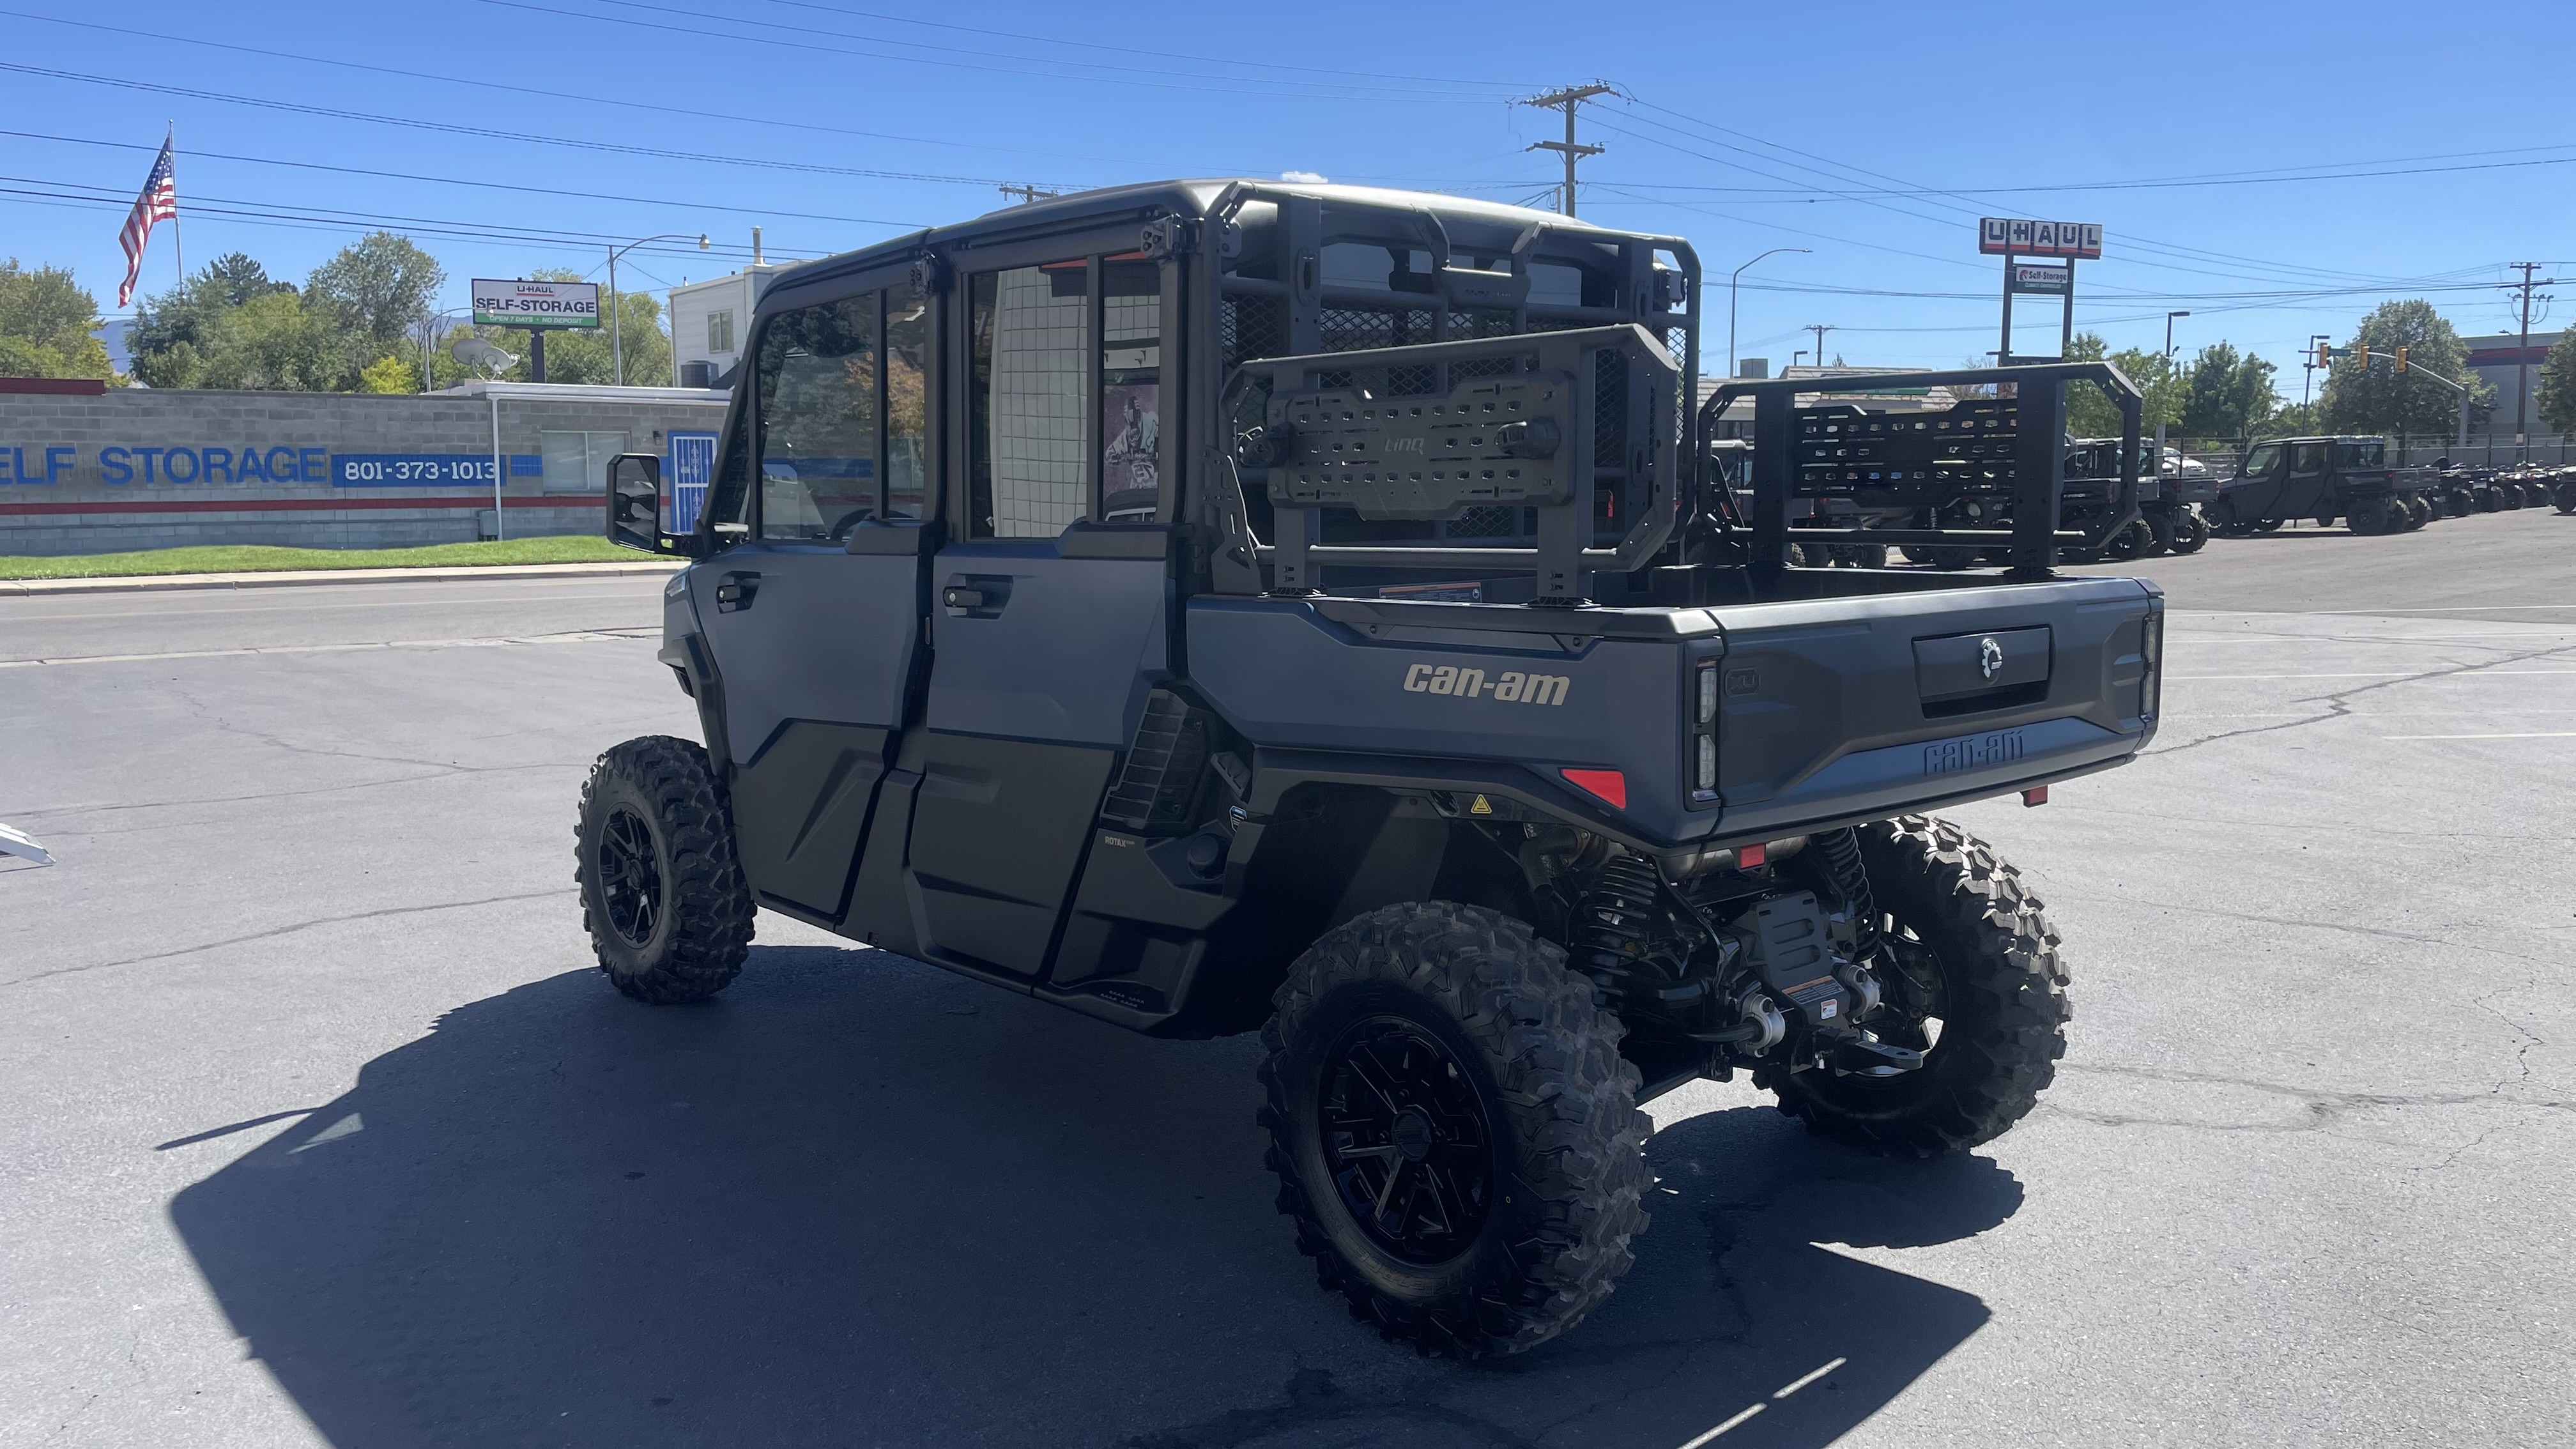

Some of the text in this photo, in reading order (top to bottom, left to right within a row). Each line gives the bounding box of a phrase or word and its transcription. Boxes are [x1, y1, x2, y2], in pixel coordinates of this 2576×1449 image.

[2028, 271, 2067, 282] Self-Storage
[476, 298, 595, 313] SELF-STORAGE
[100, 446, 327, 484] STORAGE
[345, 461, 496, 480] 801-373-1013
[1403, 664, 1570, 706] can-am
[1924, 730, 2024, 777] can-am
[1105, 836, 1126, 847] ROTAX
